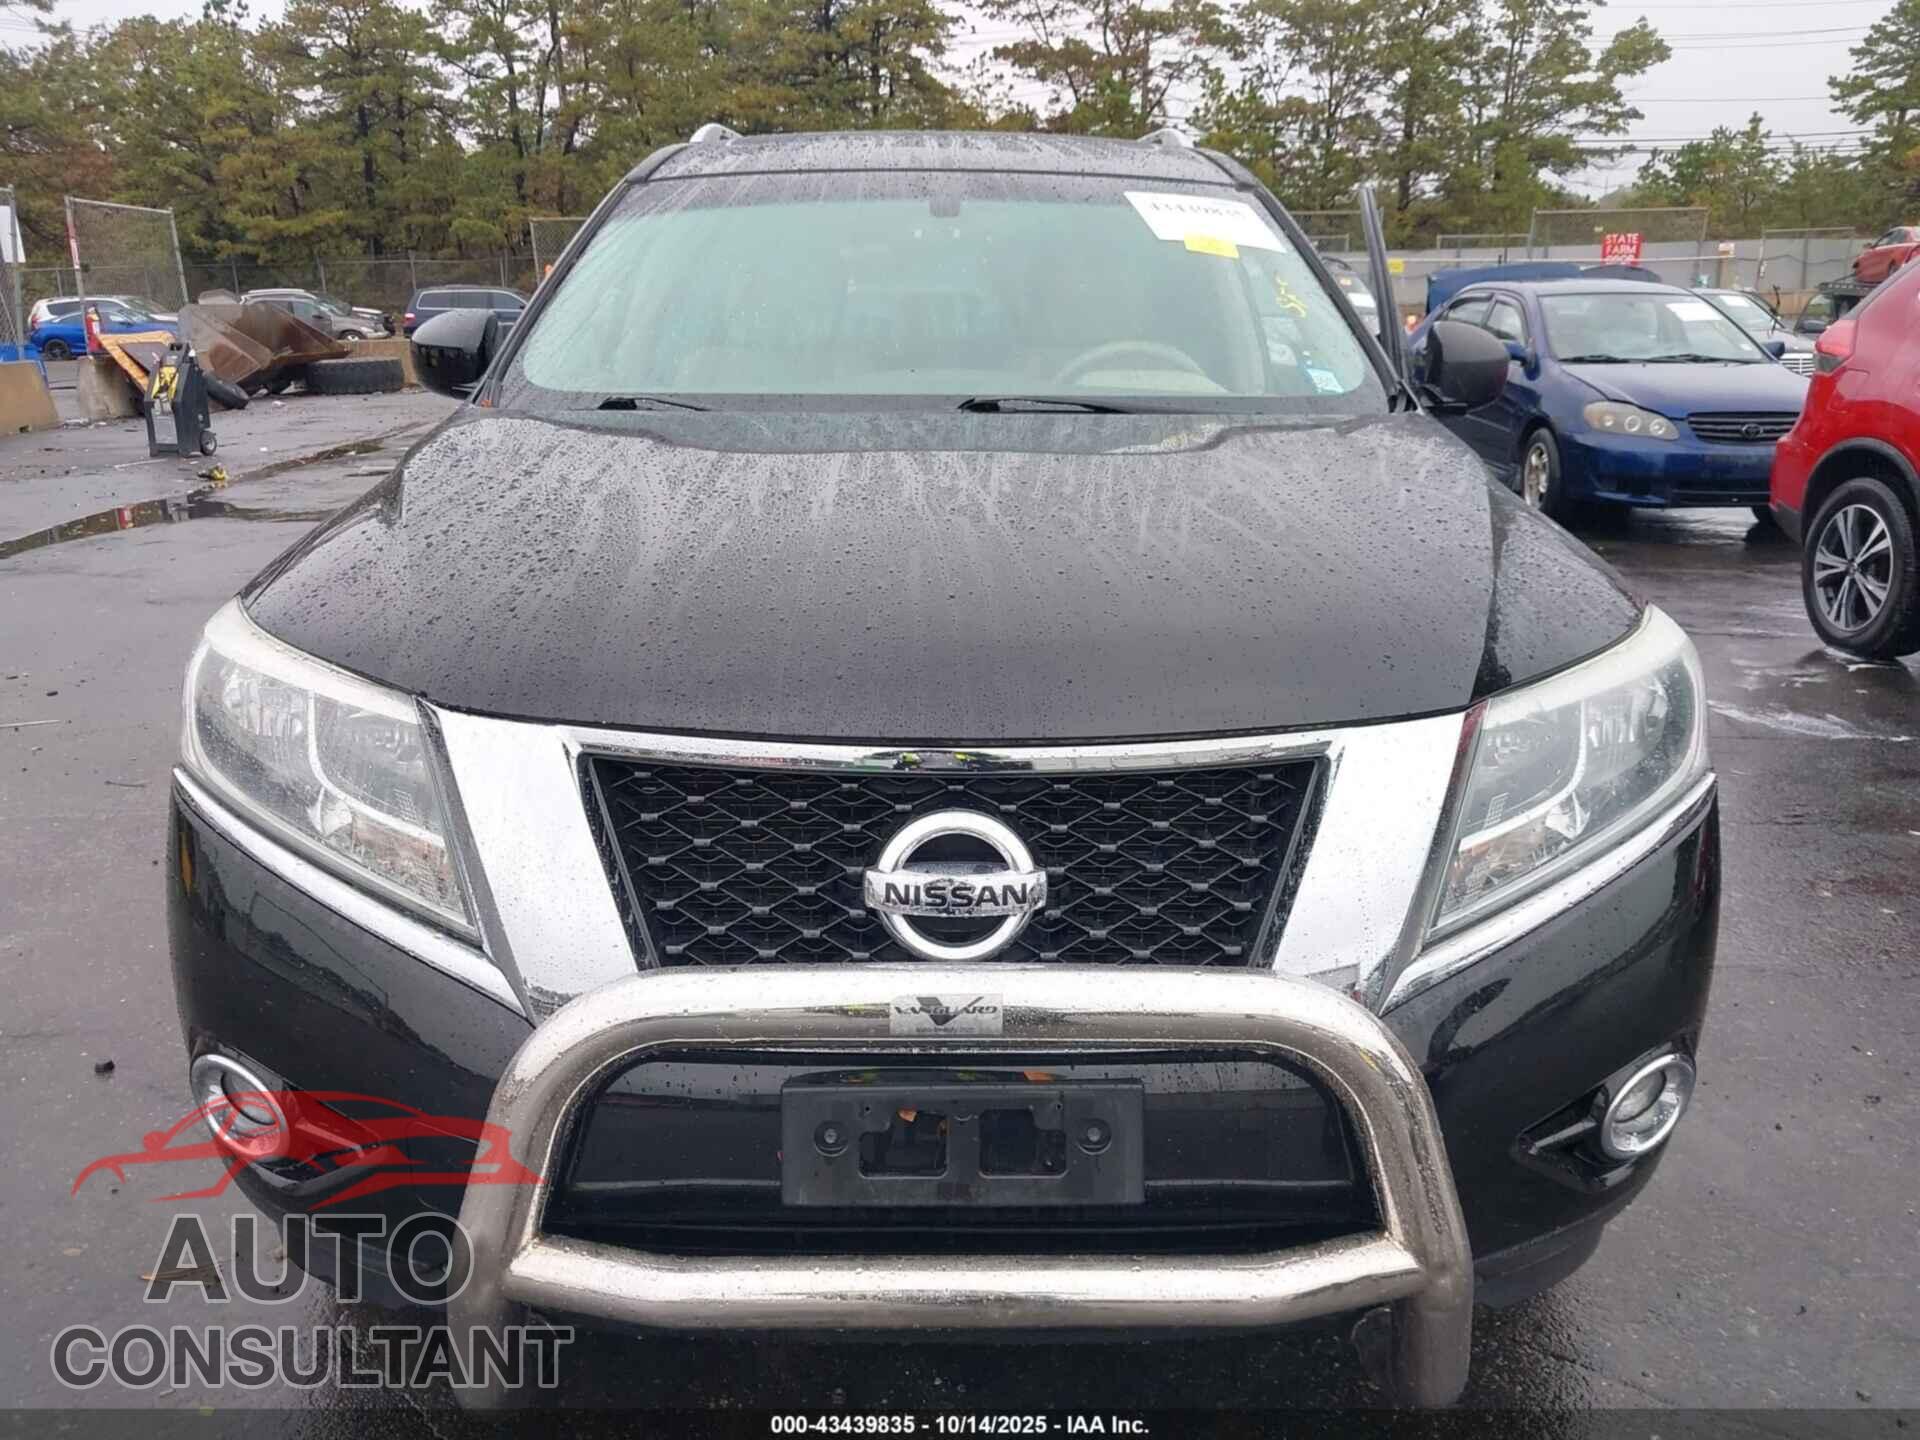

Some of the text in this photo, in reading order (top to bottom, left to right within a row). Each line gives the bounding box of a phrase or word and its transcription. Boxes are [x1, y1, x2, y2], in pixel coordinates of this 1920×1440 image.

[1605, 233, 1639, 244] STATE
[1606, 244, 1637, 256] FARM
[884, 882, 1027, 907] NISSAN
